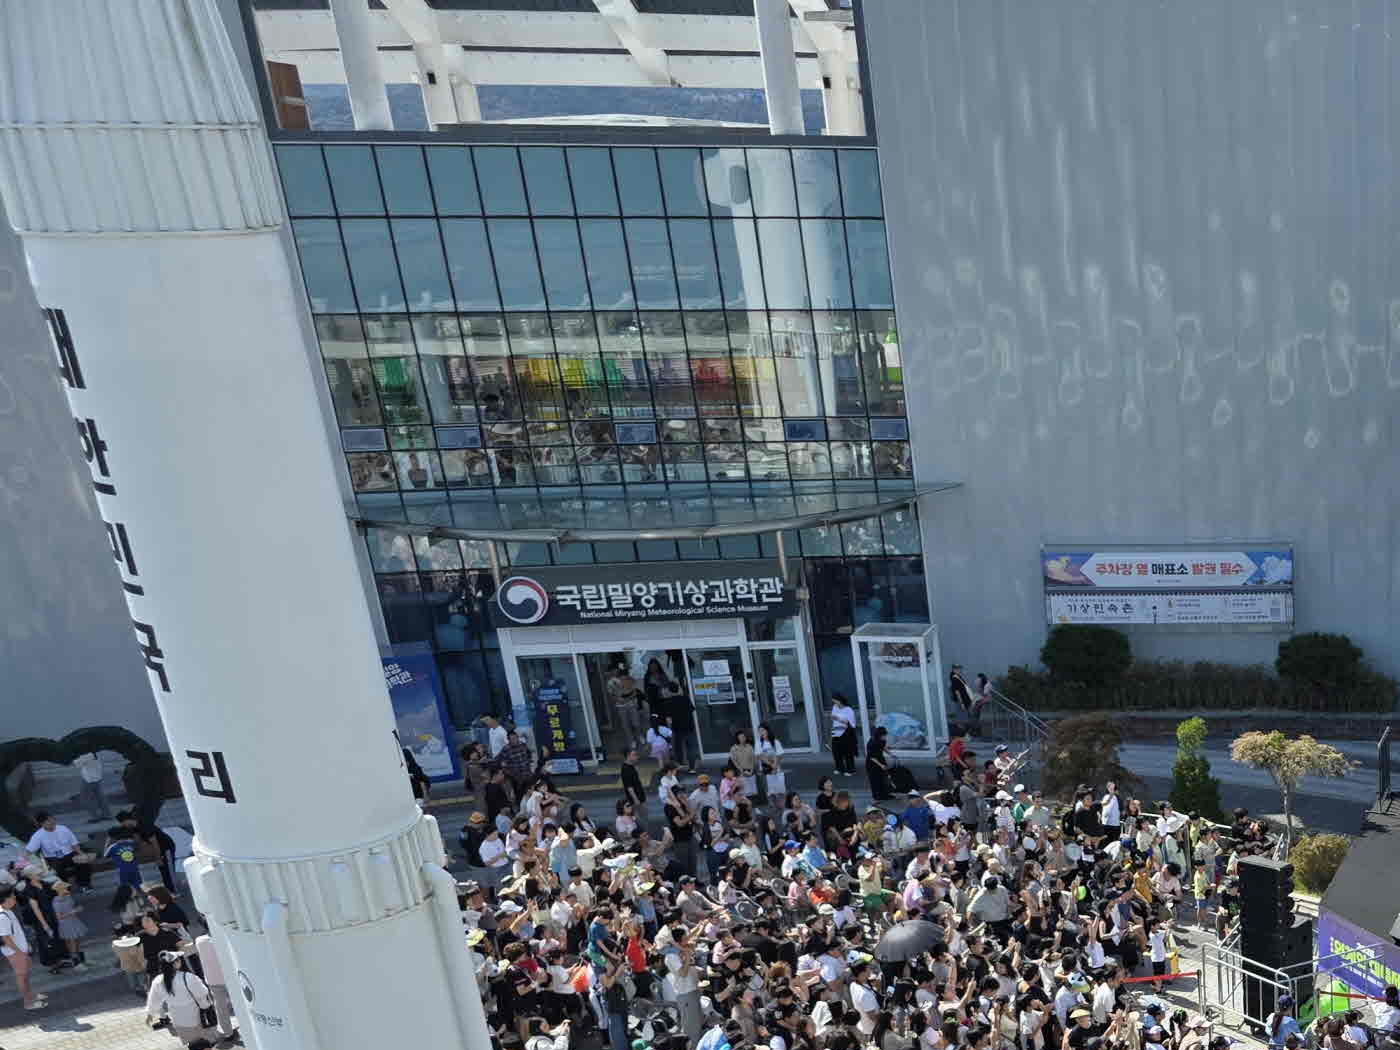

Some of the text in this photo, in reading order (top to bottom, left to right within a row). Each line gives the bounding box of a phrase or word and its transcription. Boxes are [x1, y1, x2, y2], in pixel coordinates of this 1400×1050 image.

[1151, 562, 1188, 576] 매표소
[556, 576, 784, 611] 국립밀양기상과학관
[580, 604, 769, 619] National Miryang Meteorological Science Museum
